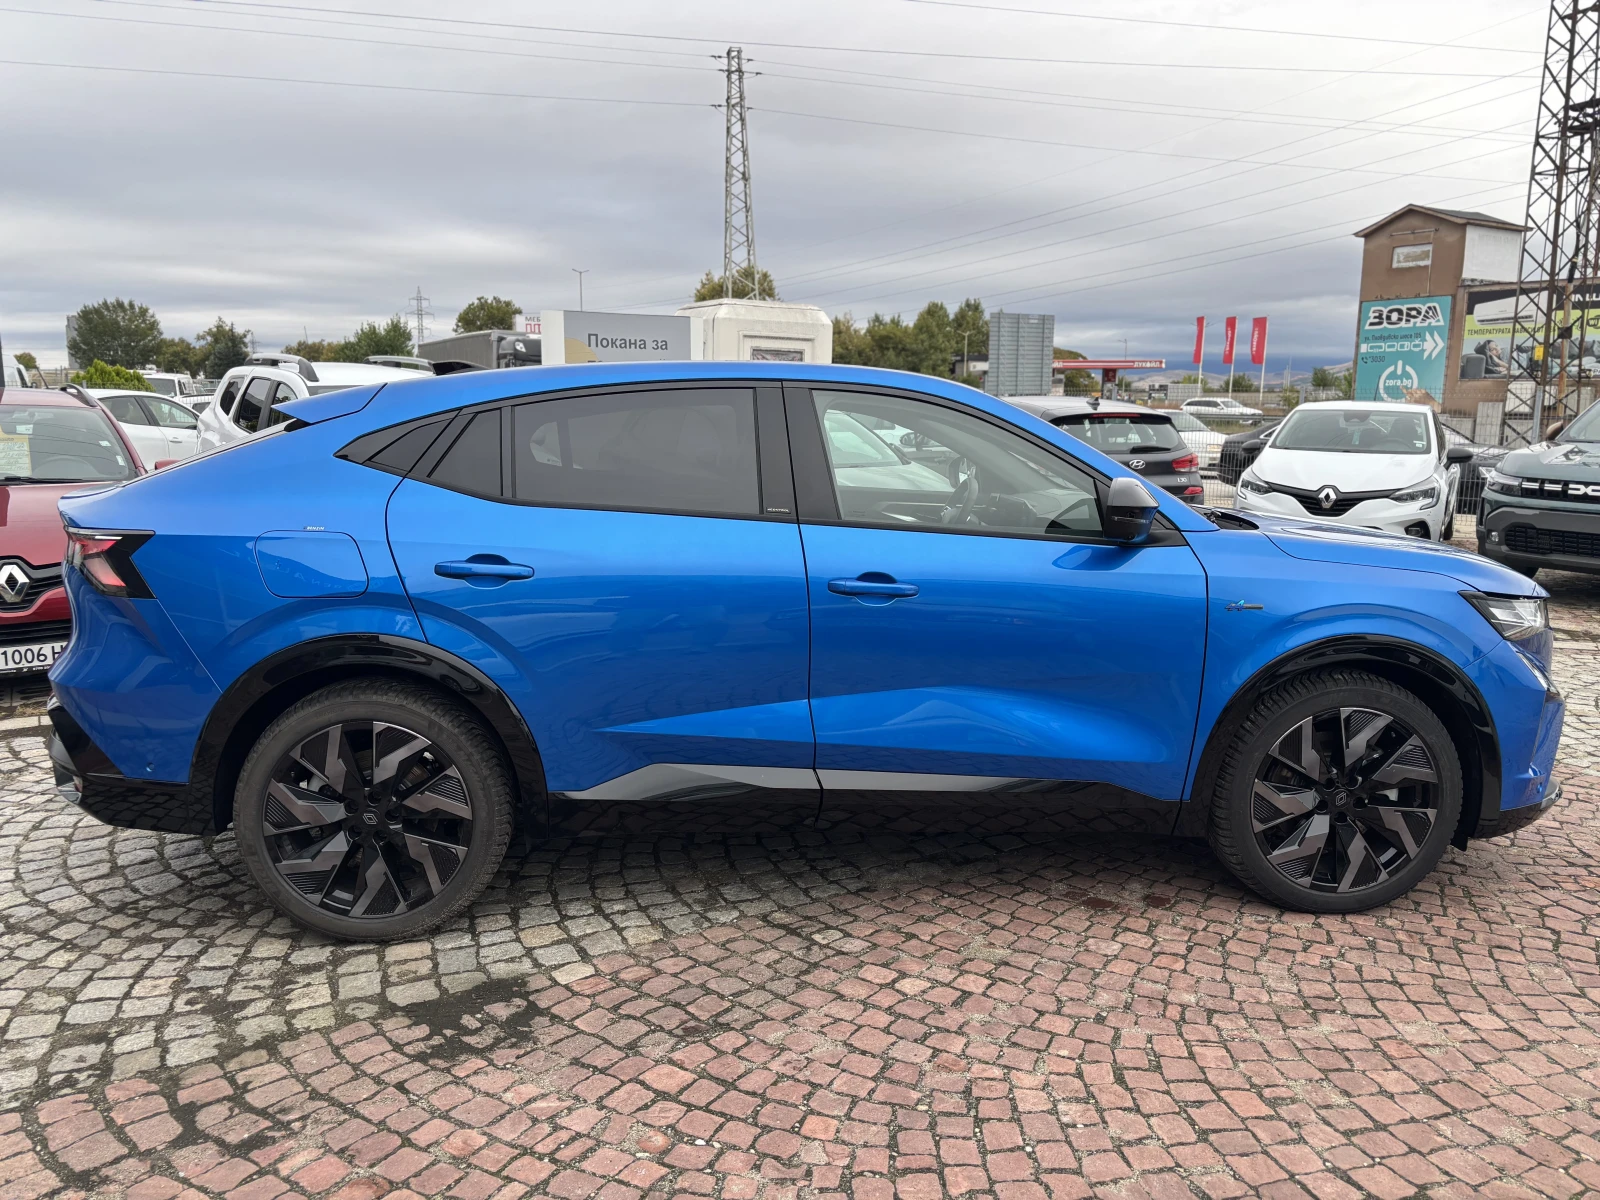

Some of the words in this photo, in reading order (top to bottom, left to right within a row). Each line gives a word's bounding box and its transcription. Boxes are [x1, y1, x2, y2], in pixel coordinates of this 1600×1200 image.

[1365, 303, 1444, 329] ЗОРА
[587, 333, 647, 350] Покана
[651, 340, 668, 350] за
[1385, 378, 1412, 387] zora.bg
[1, 647, 47, 666] 1006
